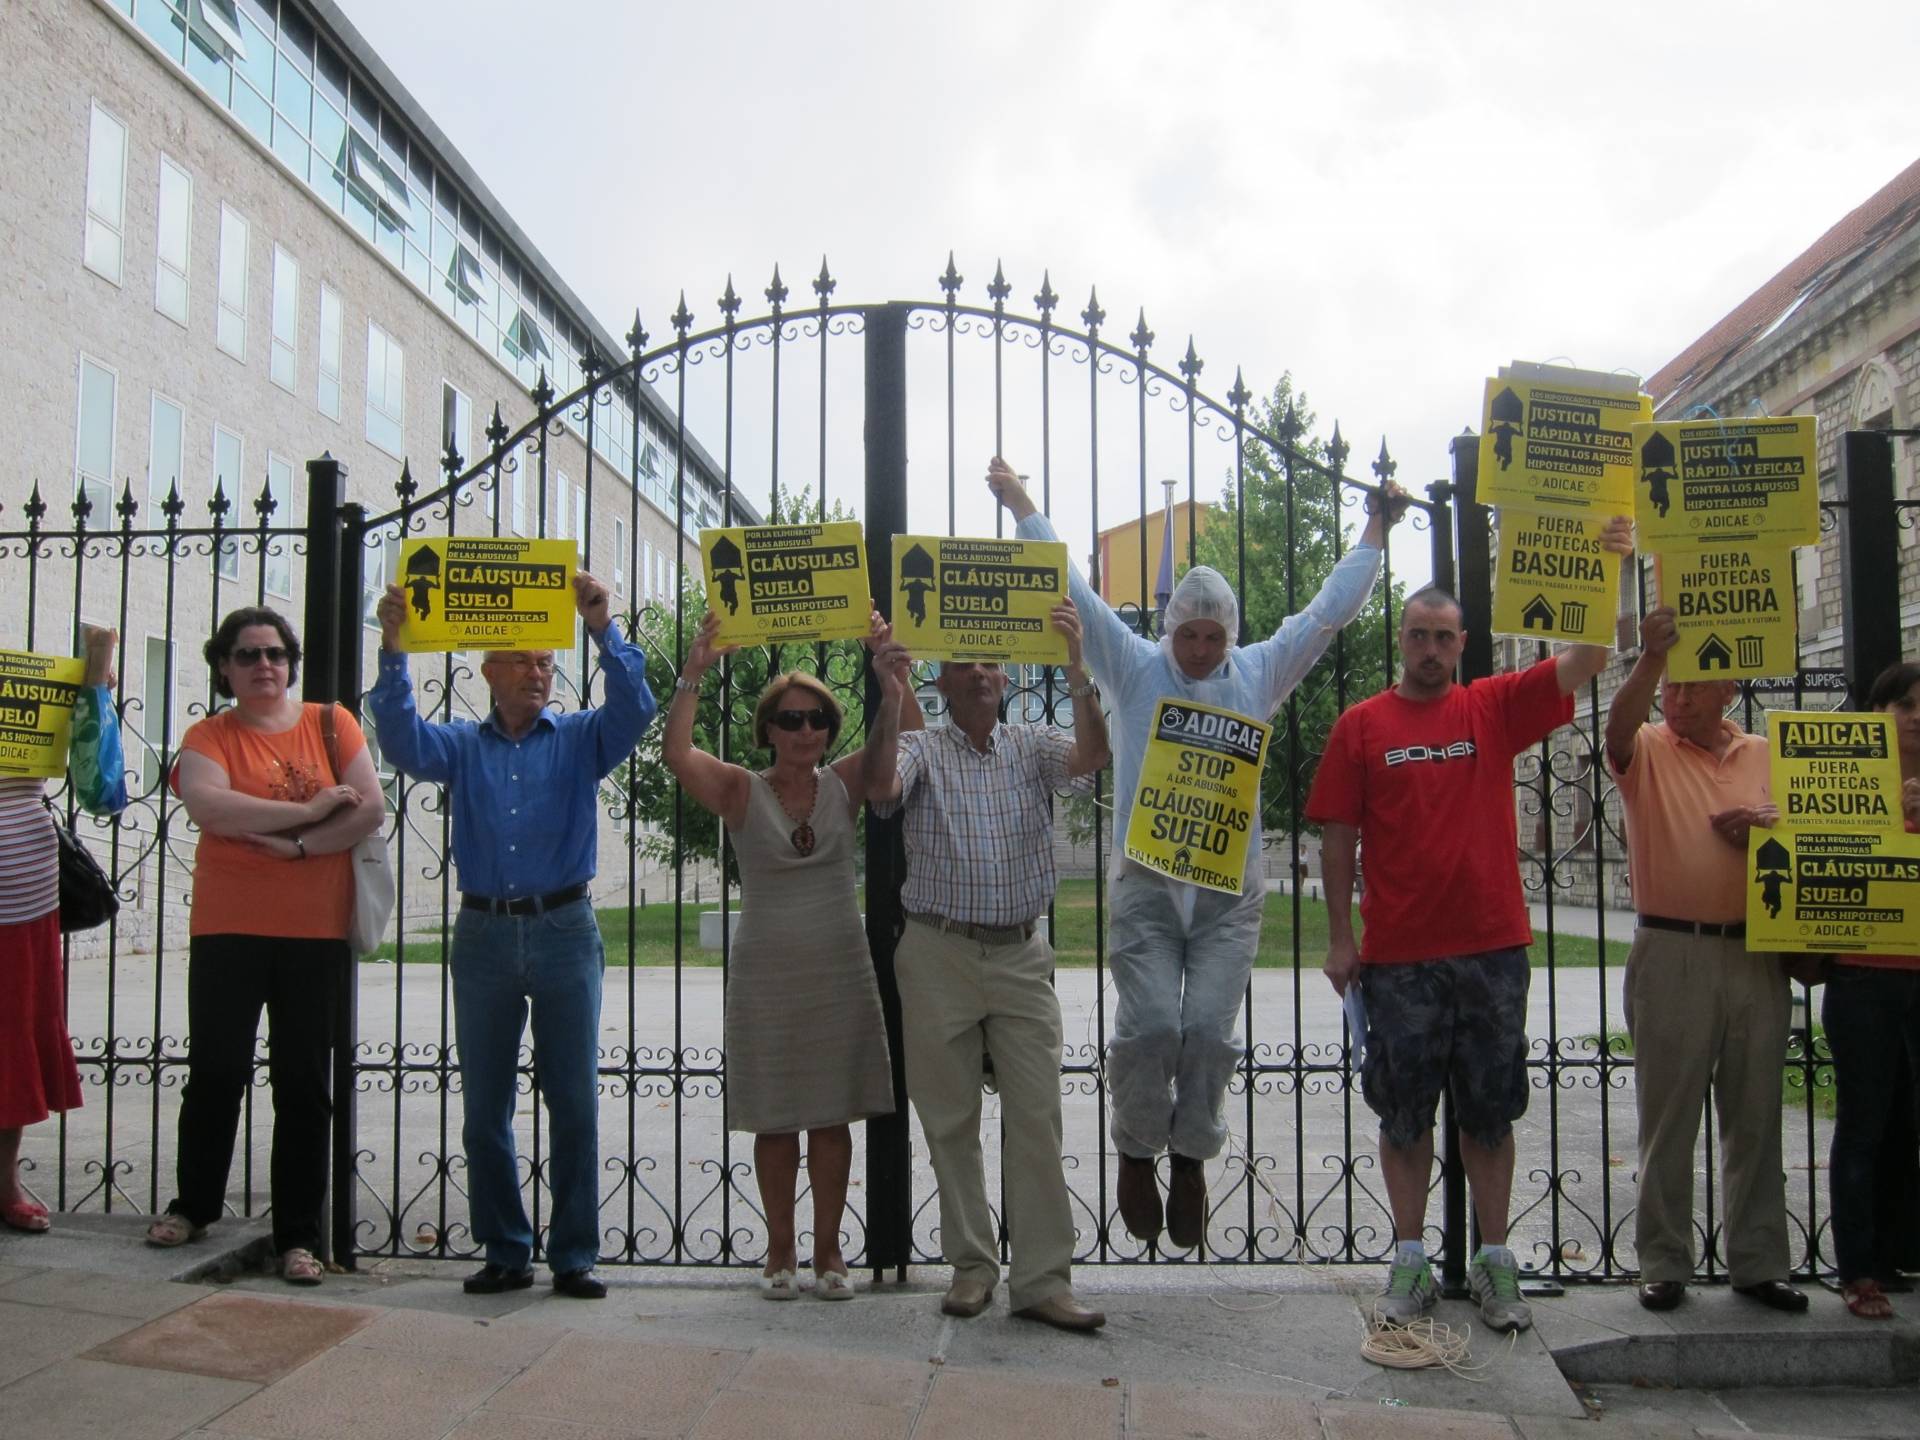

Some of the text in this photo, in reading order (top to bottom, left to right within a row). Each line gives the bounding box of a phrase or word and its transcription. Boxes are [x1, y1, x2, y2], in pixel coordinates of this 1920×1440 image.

[1532, 407, 1596, 426] JUSTICIA
[1530, 426, 1580, 442] RÁPIDA
[1584, 433, 1593, 442] Y
[1528, 445, 1632, 465] CONTRA LOS ABUSOS
[1684, 443, 1755, 462] JUSTICIA
[1528, 459, 1602, 475] HIPOTECARIOS
[1686, 462, 1802, 478] RÁPIDA Y EFICAZ
[1542, 477, 1584, 492] ADICAE
[1686, 480, 1796, 495] CONTRA LOS ABUSOS
[1686, 497, 1765, 509] HIPOTECARIOS
[1538, 516, 1584, 535] FUERA
[1705, 514, 1749, 527] ADICAE
[478, 543, 528, 551] REGULACIÓN
[1518, 532, 1600, 554] HIPOTECAS
[751, 552, 855, 572] CLÁUSULAS
[1512, 550, 1604, 582] BASURA
[1701, 553, 1750, 569] FUERA
[449, 566, 561, 587] CLÁUSULAS
[944, 568, 1054, 588] CLÁUSULAS
[1682, 569, 1770, 587] HIPOTECAS
[754, 580, 809, 596] SUELO
[449, 593, 509, 607] SUELO
[771, 604, 790, 612] LAS
[792, 600, 846, 610] HIPOTECAS
[944, 596, 1003, 611] SUELO
[1679, 588, 1778, 616] BASURA
[487, 614, 546, 622] HIPOTECAS
[772, 615, 812, 628] ADICAE
[944, 620, 1041, 630] EN LAS HIPOTECAS
[465, 626, 507, 635] ADICAE
[959, 634, 1002, 645] ADICAE
[8, 657, 54, 668] REGULACIÓN
[2, 680, 76, 704] ÁUSULAS
[1184, 712, 1263, 752] ADICAE
[1786, 723, 1882, 745] ADICAE
[1178, 750, 1235, 781] STOP
[1809, 762, 1859, 774] FUERA
[1167, 774, 1238, 798] A LAS ABUSIVAS
[1791, 777, 1879, 790] HIPOTECAS
[1140, 787, 1249, 832] CLÁUSULAS
[1788, 793, 1888, 815] BASURA
[1151, 814, 1229, 855] SUELO
[1828, 835, 1879, 844] REGULACIÓN
[1129, 848, 1237, 890] EN LAS HIPOTECAS
[1801, 860, 1919, 879] CLÁUSULAS
[1801, 887, 1863, 902] SUELO
[1800, 911, 1901, 921] EN LAS HIPOTECAS
[1815, 926, 1860, 936] ADICAE
